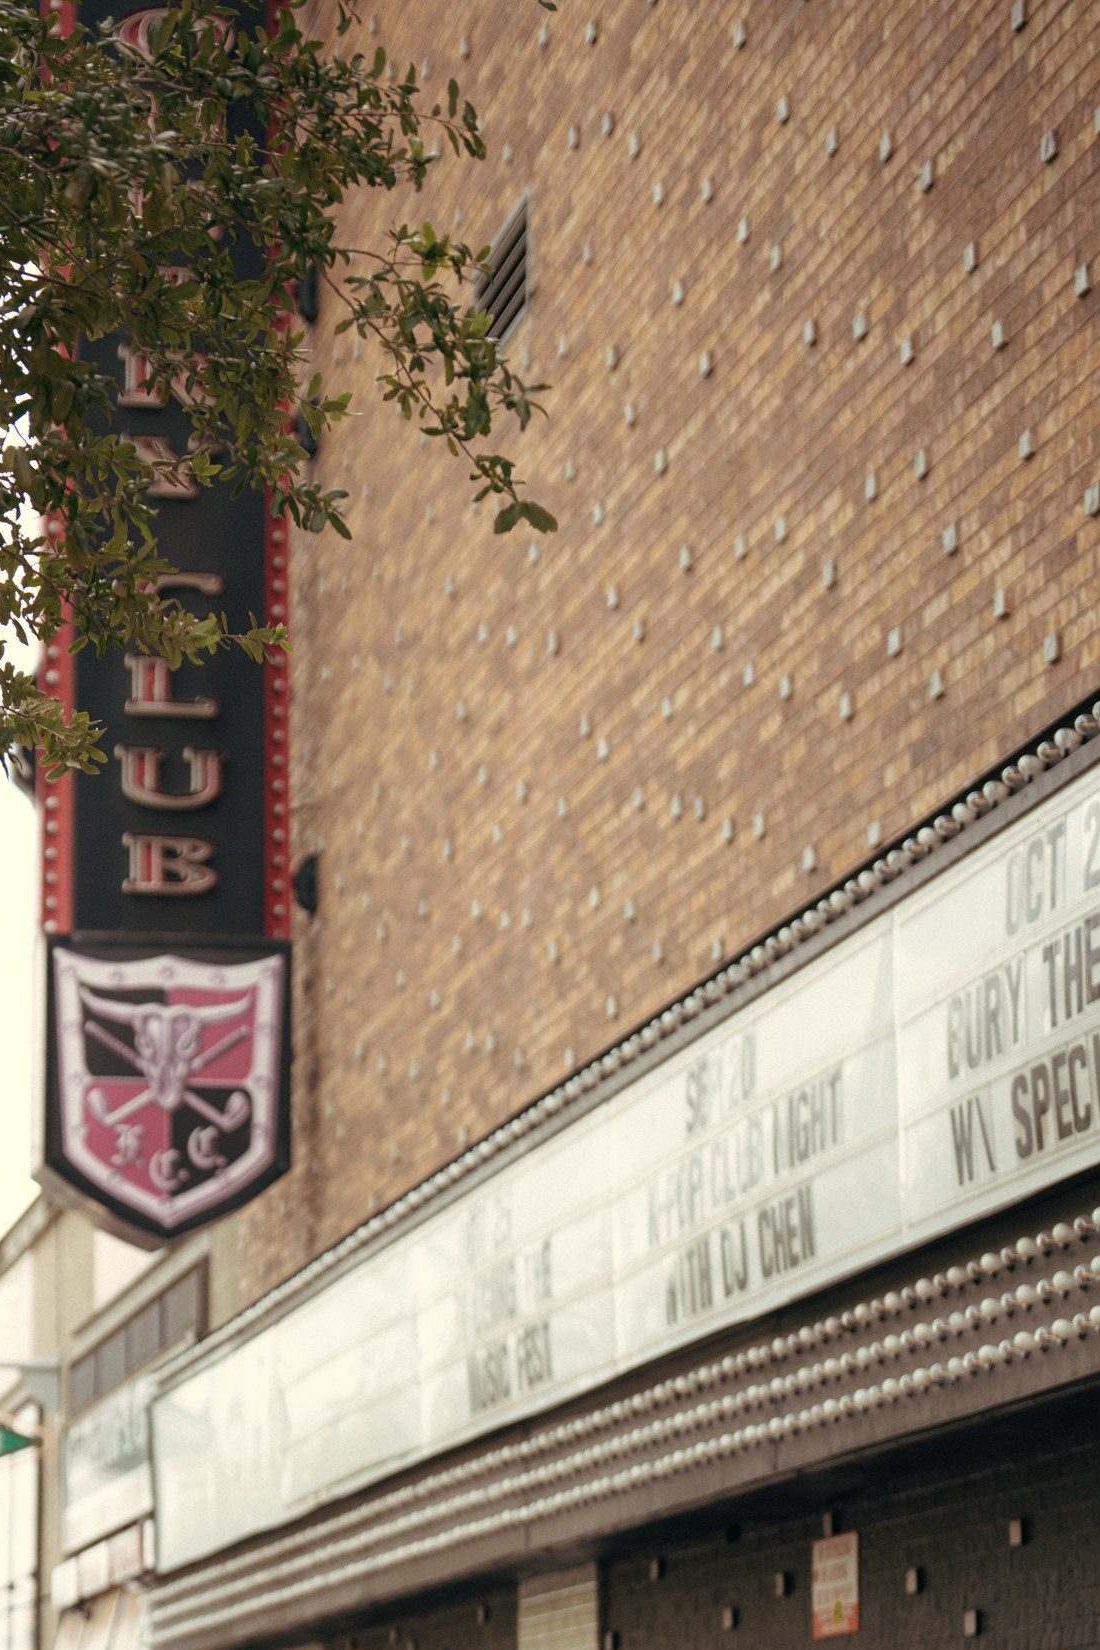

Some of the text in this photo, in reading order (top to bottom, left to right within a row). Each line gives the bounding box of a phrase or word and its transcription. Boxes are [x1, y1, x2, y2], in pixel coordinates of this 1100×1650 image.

[1006, 821, 1064, 937] OCT
[947, 957, 1024, 1080] BURY
[773, 1066, 842, 1177] NIGHT
[665, 1184, 815, 1326] WITH DJ CHEN
